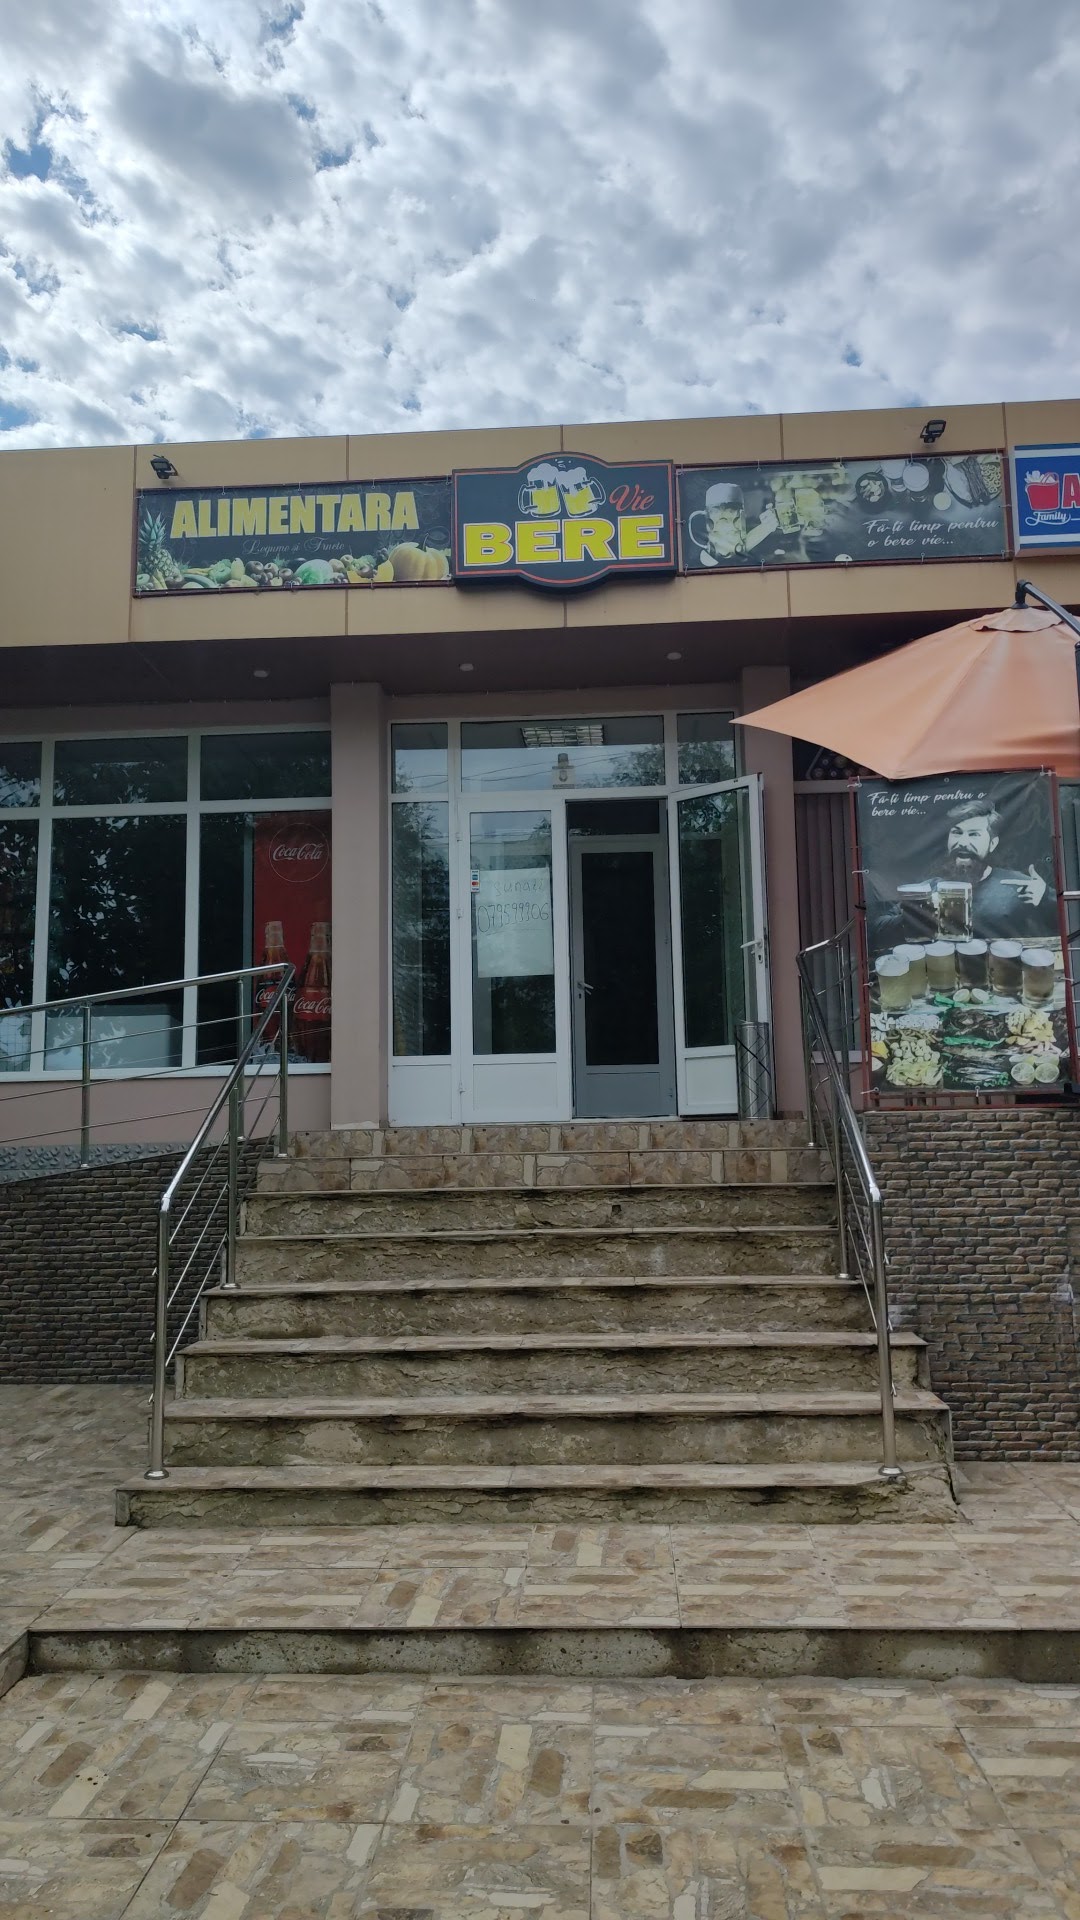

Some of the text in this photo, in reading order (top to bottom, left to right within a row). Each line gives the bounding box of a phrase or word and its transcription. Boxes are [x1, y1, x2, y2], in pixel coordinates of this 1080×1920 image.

[609, 484, 655, 512] Vie
[1061, 472, 1080, 509] A
[169, 491, 419, 539] ALIMENTARA
[909, 519, 944, 534] timp
[947, 516, 999, 533] pentru
[1025, 511, 1071, 527] Family
[463, 514, 665, 567] BERE
[867, 540, 879, 548] o
[884, 535, 917, 547] bere
[903, 792, 931, 805] timp
[933, 789, 974, 804] pentru
[871, 806, 897, 817] bere
[477, 901, 550, 933] 079599906
